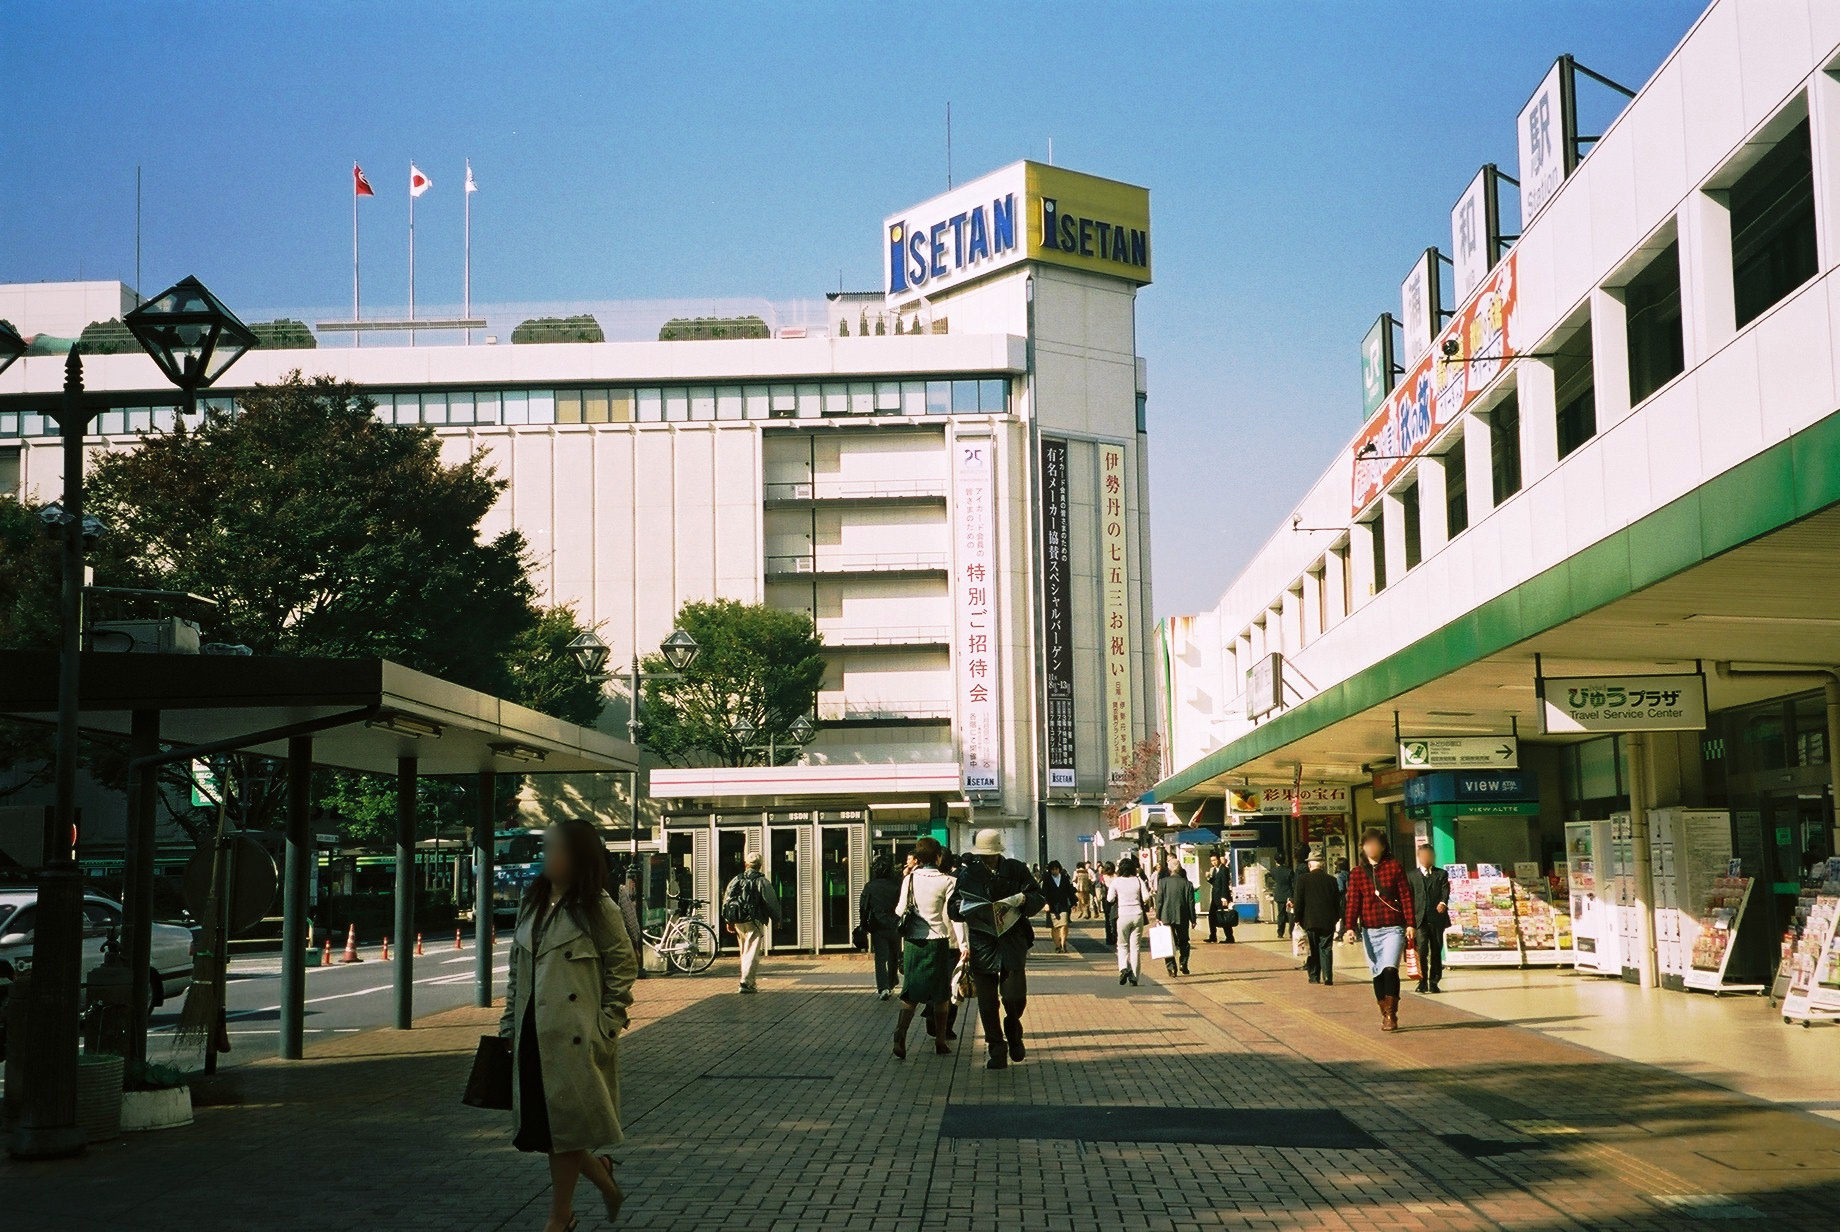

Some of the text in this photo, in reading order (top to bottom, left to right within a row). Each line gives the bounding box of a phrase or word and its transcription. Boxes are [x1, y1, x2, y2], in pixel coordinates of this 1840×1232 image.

[1529, 89, 1552, 178] 駅
[1527, 168, 1559, 218] Station
[1459, 195, 1476, 266] 和
[1046, 447, 1063, 671] 有名メーカー協賛スペシャルバーゲン
[1105, 451, 1125, 676] 伊勢丹の七五三お祝い
[966, 563, 988, 703] 特別ご招待会
[1568, 687, 1682, 709] びゅうプラザ
[1570, 708, 1683, 720] Travel Service Center
[1263, 787, 1345, 801] 彩果の宝石
